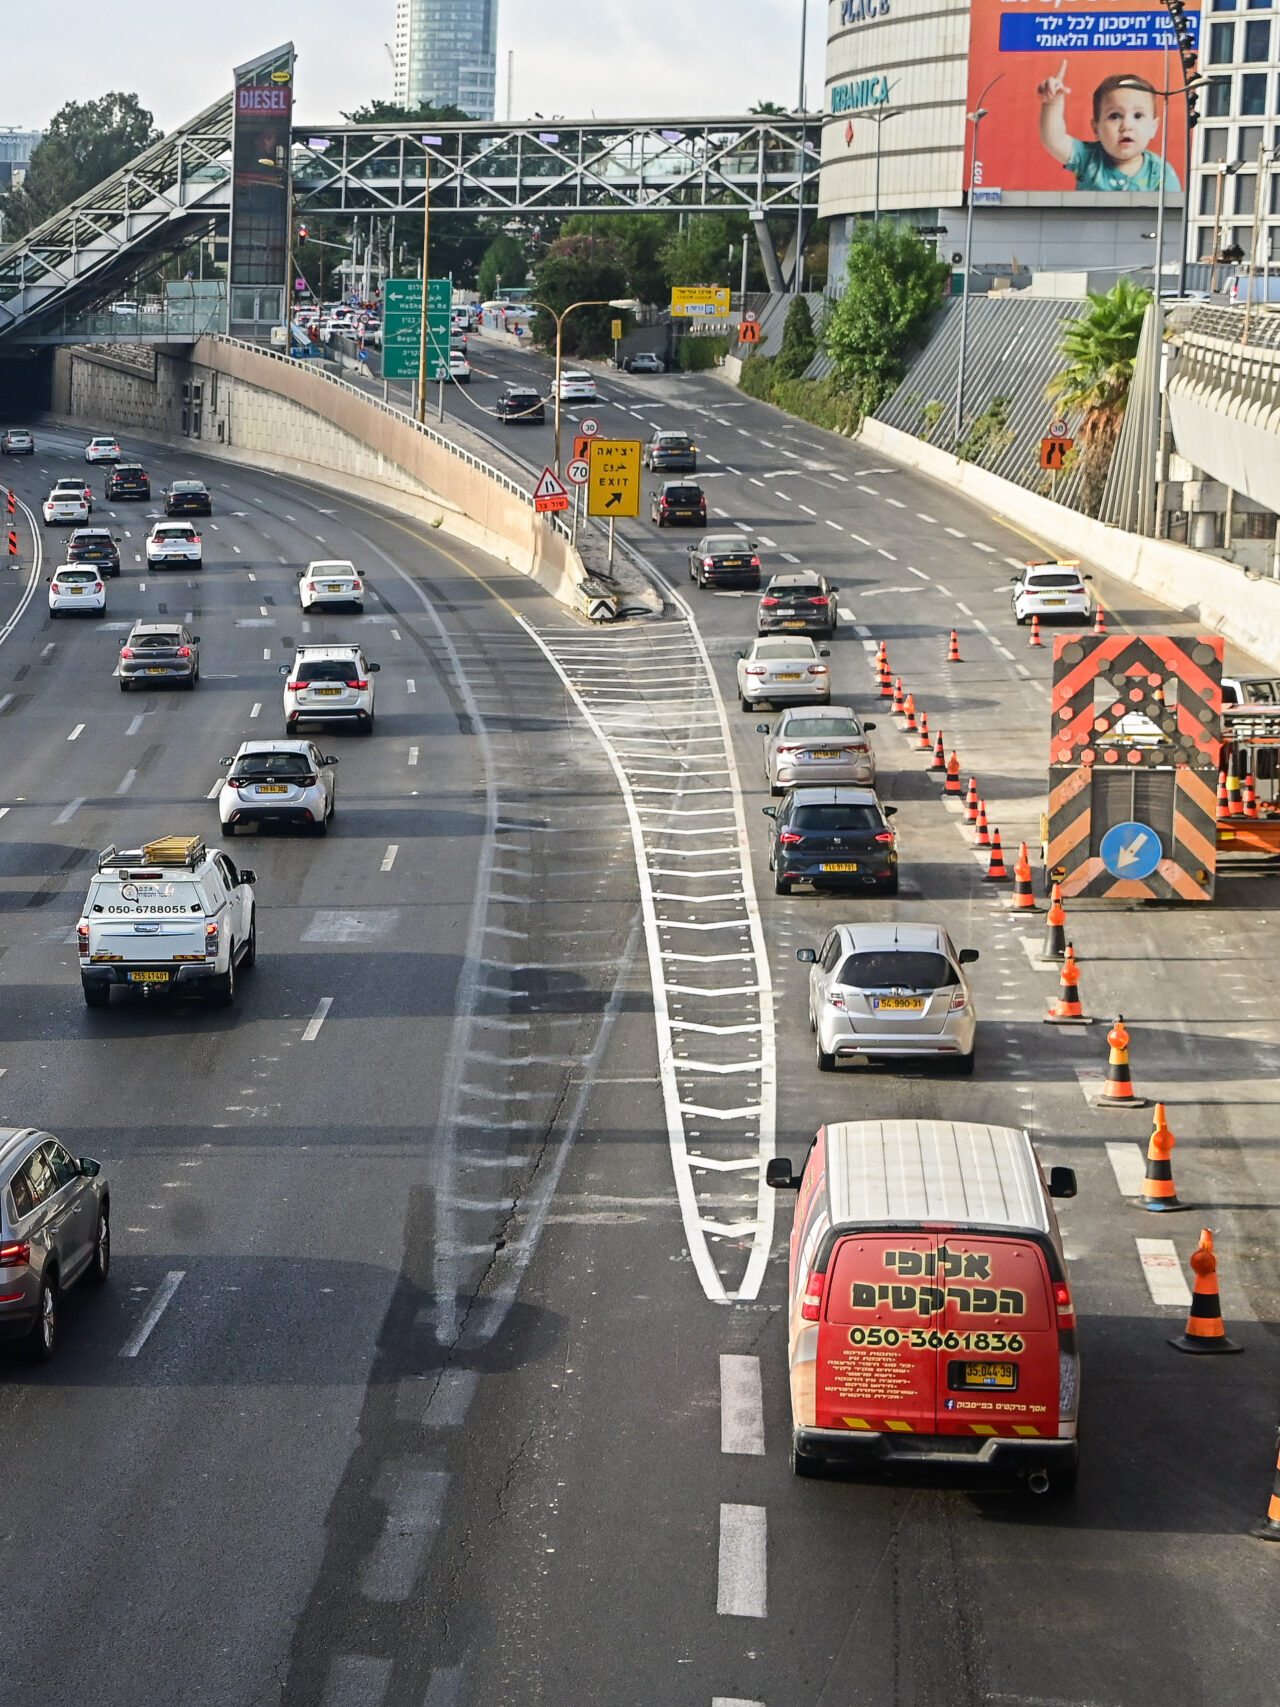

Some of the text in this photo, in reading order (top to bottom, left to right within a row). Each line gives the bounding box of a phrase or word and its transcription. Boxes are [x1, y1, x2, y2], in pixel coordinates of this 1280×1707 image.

[1067, 15, 1096, 30] לכל
[1036, 32, 1195, 47] תר הביטוח הלאומי
[240, 90, 287, 109] DIESEL
[832, 75, 890, 114] URBANICA
[585, 424, 595, 432] 30
[597, 447, 633, 456] יציאה
[572, 466, 588, 478] 70
[603, 463, 627, 473] خروج
[599, 478, 629, 487] EXIT
[108, 905, 187, 914] 050-6788055
[885, 1245, 991, 1281] אלופי
[851, 1282, 1024, 1316] הפרקטים
[849, 1327, 1024, 1354] 050-3661836
[995, 1403, 1027, 1411] פרקטים
